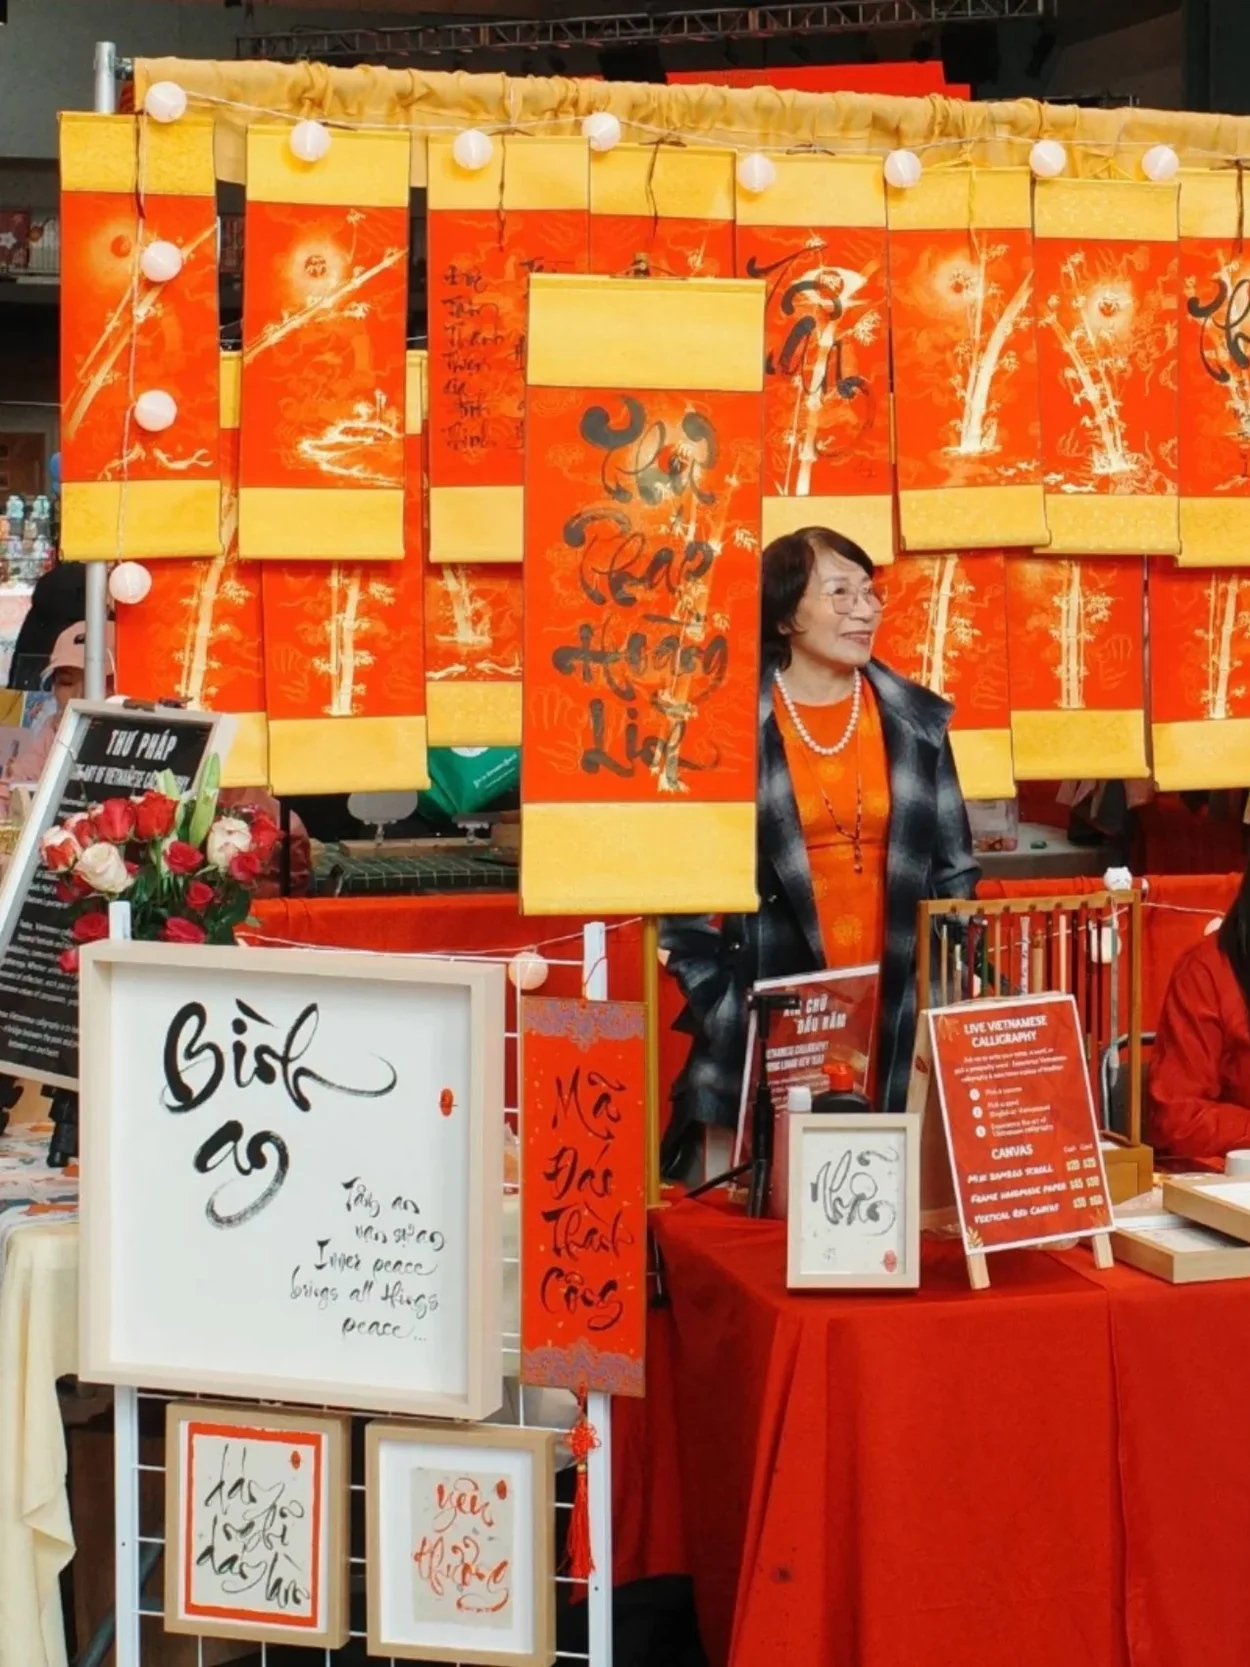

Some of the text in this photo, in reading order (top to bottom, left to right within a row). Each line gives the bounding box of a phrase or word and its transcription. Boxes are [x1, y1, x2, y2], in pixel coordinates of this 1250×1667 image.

[106, 728, 178, 761] THƯ PHÁP
[964, 1015, 1047, 1034] LIVE VIETNAMESE
[971, 1030, 1038, 1048] CALLIGRAPHY
[991, 1144, 1034, 1160] CANVAS
[314, 1238, 439, 1282] Inner peace
[290, 1264, 439, 1320] brings all things
